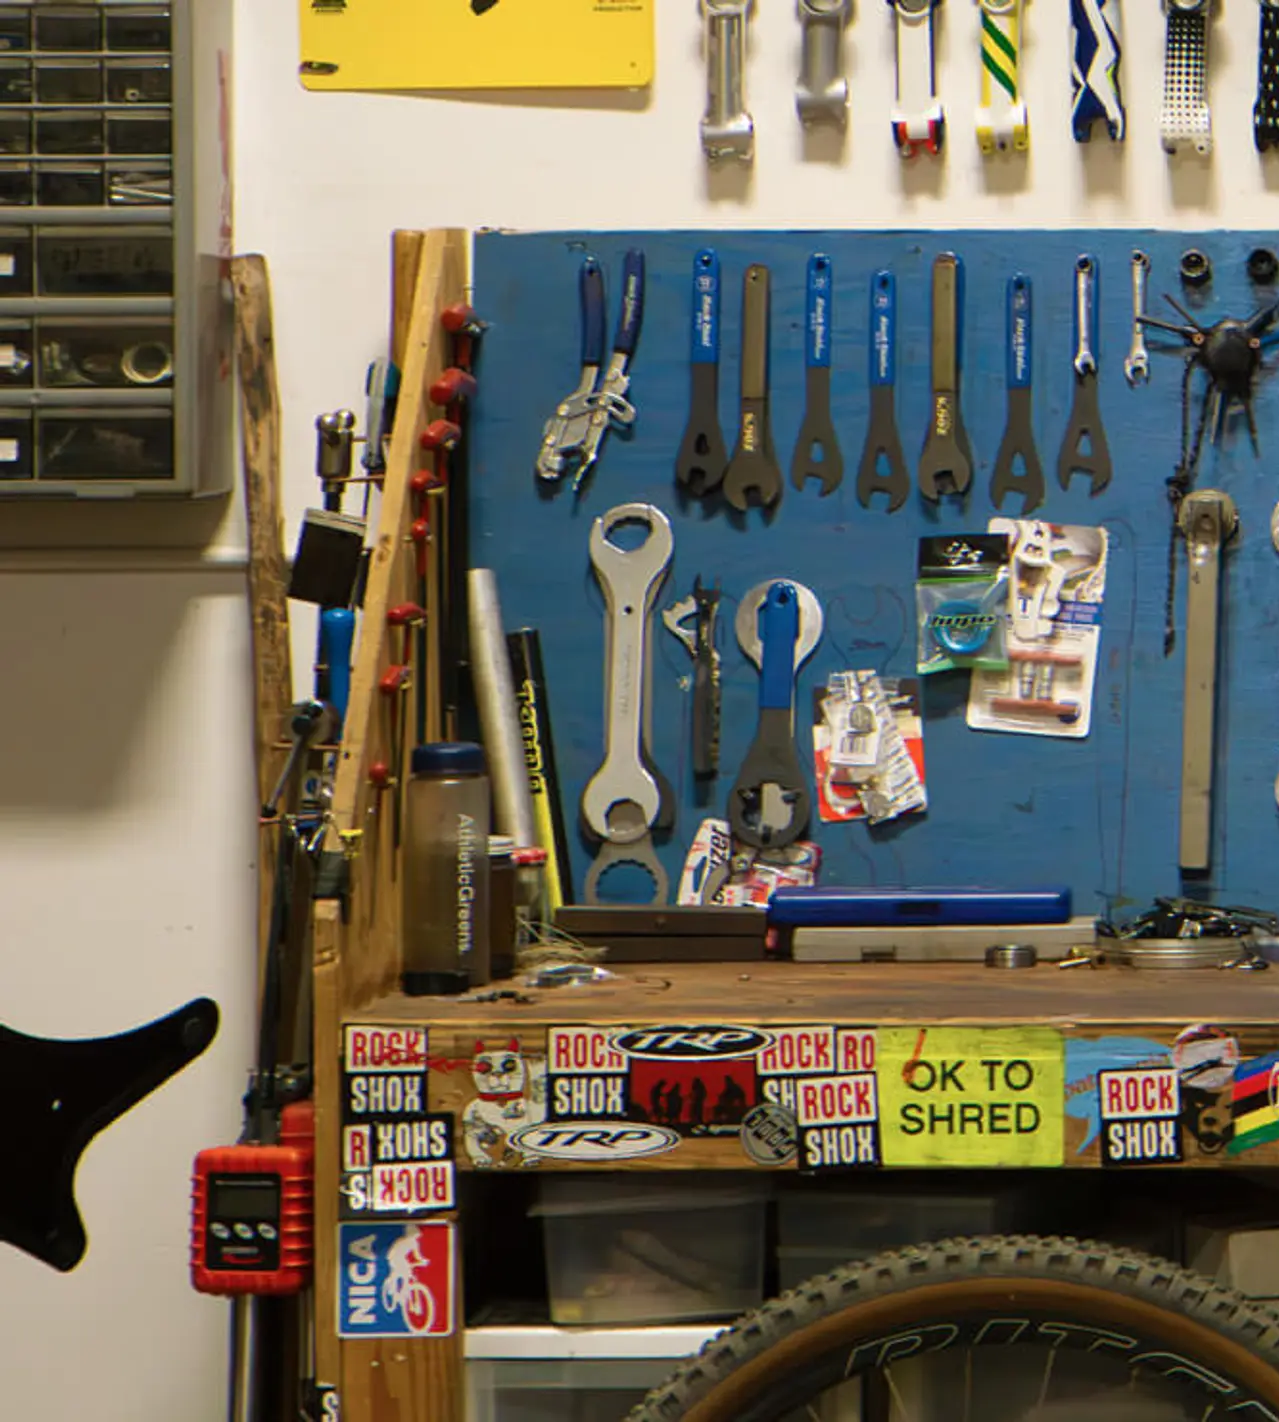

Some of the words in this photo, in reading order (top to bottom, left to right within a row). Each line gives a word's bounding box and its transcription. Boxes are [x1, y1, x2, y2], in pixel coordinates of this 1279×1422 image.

[351, 1030, 426, 1067] ROCK
[633, 1028, 754, 1051] TRP
[351, 1075, 422, 1113] SHOX
[907, 1059, 966, 1093] OK
[981, 1059, 1034, 1092] TO
[1106, 1075, 1174, 1114] ROCK
[554, 1076, 625, 1115] SHOX
[803, 1081, 872, 1120] ROCK
[899, 1102, 1041, 1136] SHRED
[377, 1120, 448, 1160] SHOX
[537, 1129, 652, 1149] TRP
[805, 1125, 875, 1167] SHOX
[1109, 1119, 1177, 1160] SHOX
[379, 1166, 448, 1204] ROCK
[347, 1233, 378, 1325] NICA
